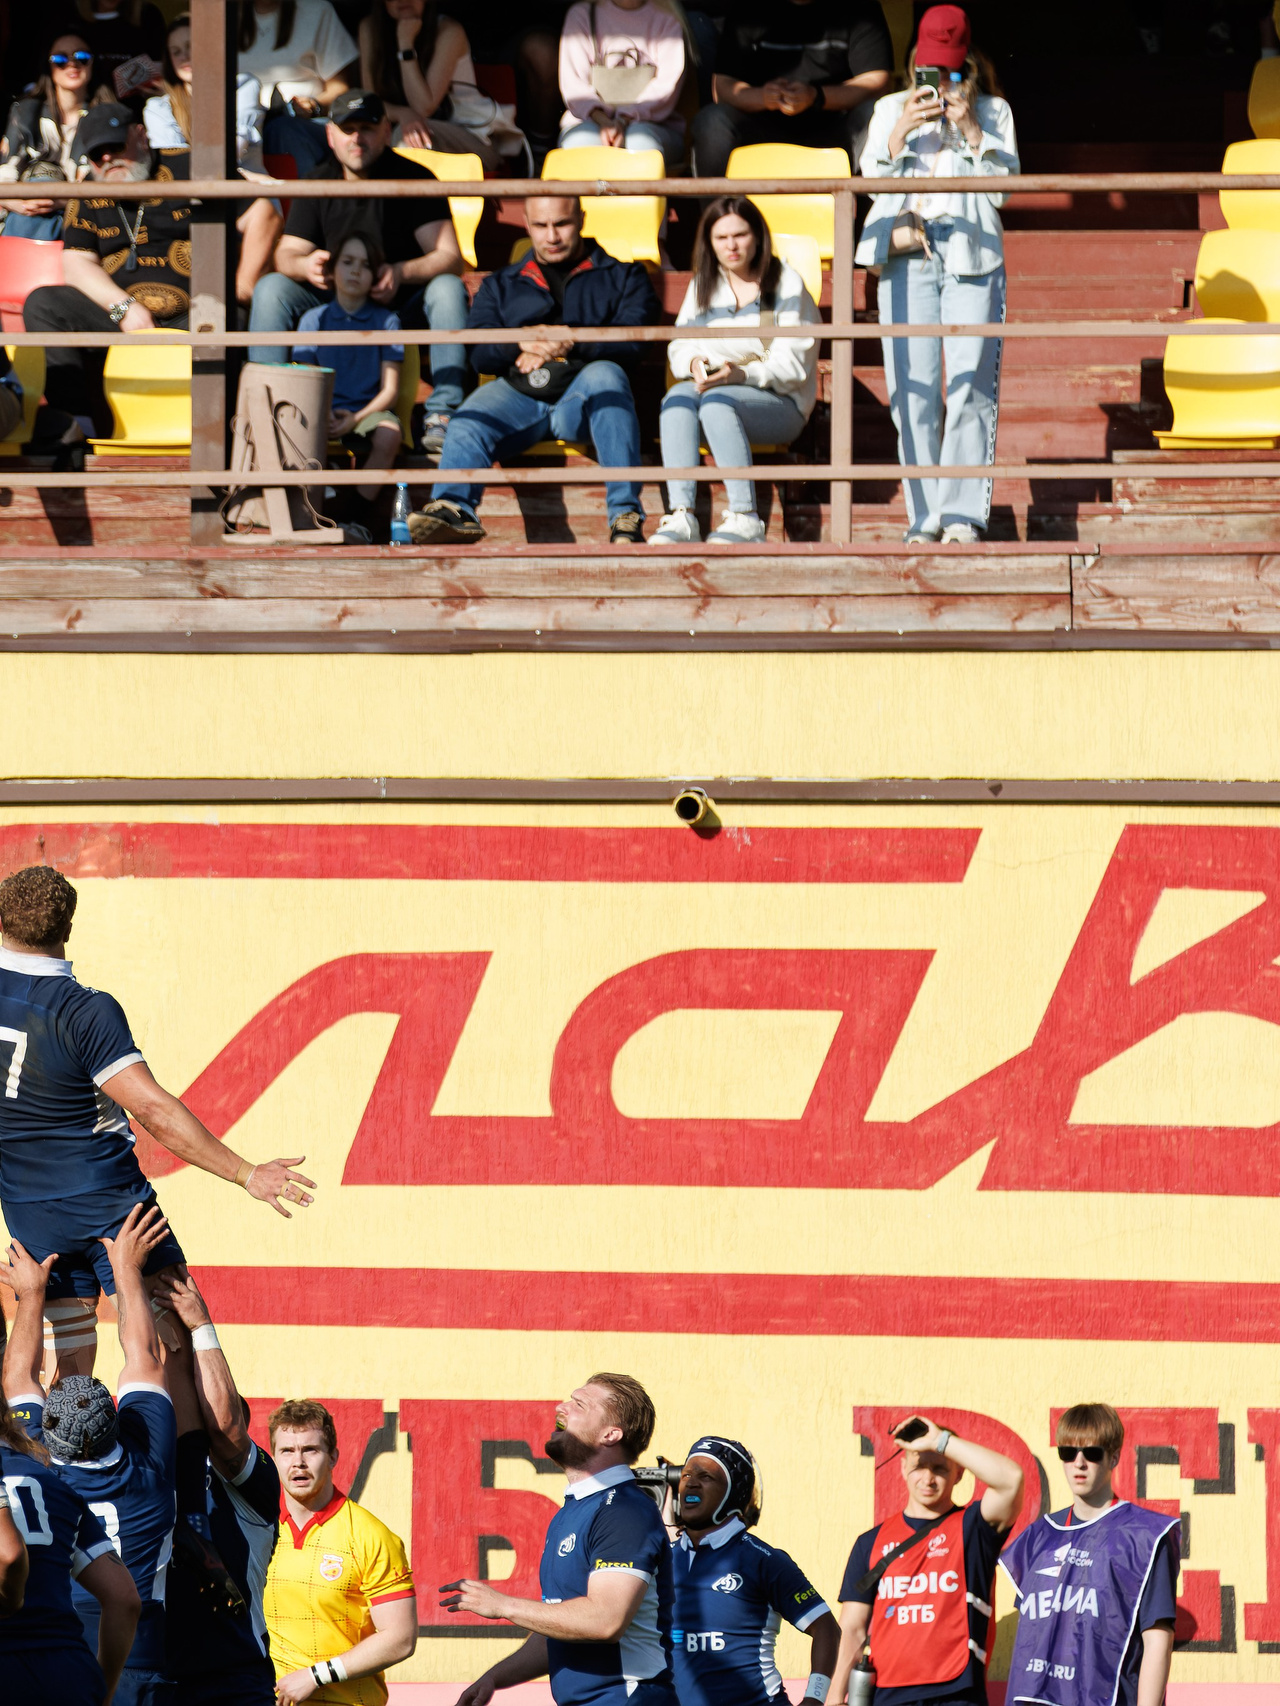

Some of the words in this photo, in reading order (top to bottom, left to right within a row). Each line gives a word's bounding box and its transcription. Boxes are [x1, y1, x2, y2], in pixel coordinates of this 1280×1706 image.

[877, 1570, 959, 1600] MEDIC
[897, 1604, 936, 1625] ВТБ
[686, 1631, 726, 1652] ВТБ
